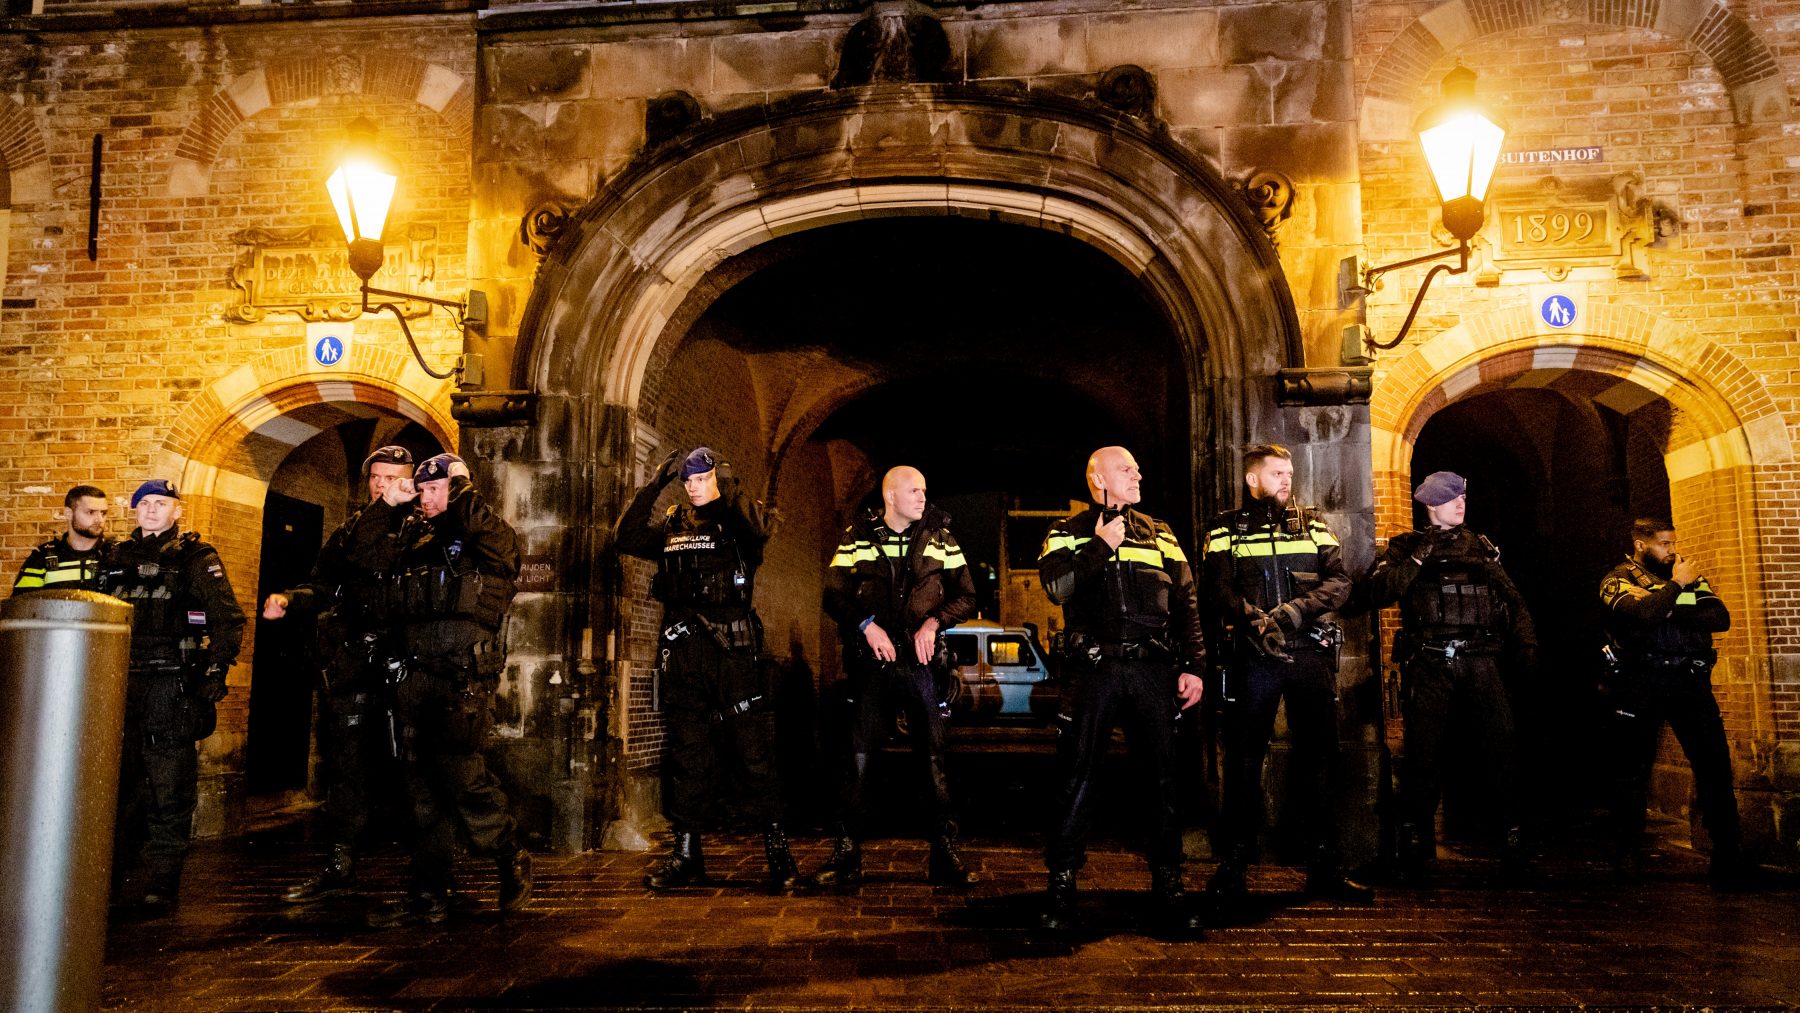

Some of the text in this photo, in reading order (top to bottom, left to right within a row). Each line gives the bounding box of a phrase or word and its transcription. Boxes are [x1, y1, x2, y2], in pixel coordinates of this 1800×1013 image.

[1499, 148, 1600, 163] BUITENHOF
[1513, 212, 1593, 243] 1899
[526, 575, 549, 583] LICHT
